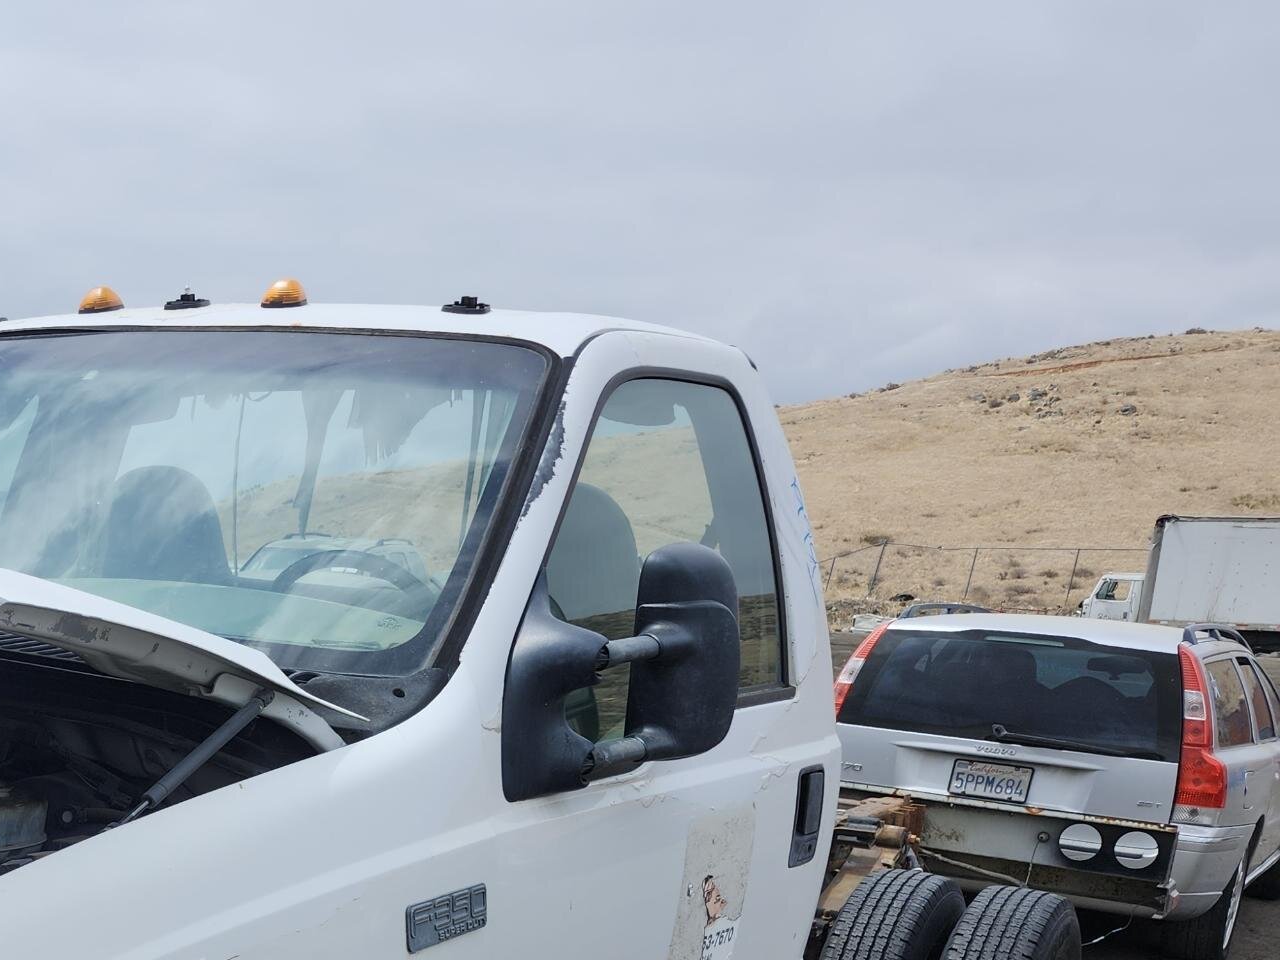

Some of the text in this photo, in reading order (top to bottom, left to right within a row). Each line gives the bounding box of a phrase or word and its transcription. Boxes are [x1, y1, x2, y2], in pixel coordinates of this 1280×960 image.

[975, 744, 1017, 756] VOLVO
[969, 762, 1014, 775] California
[954, 771, 1024, 797] 5PPM684
